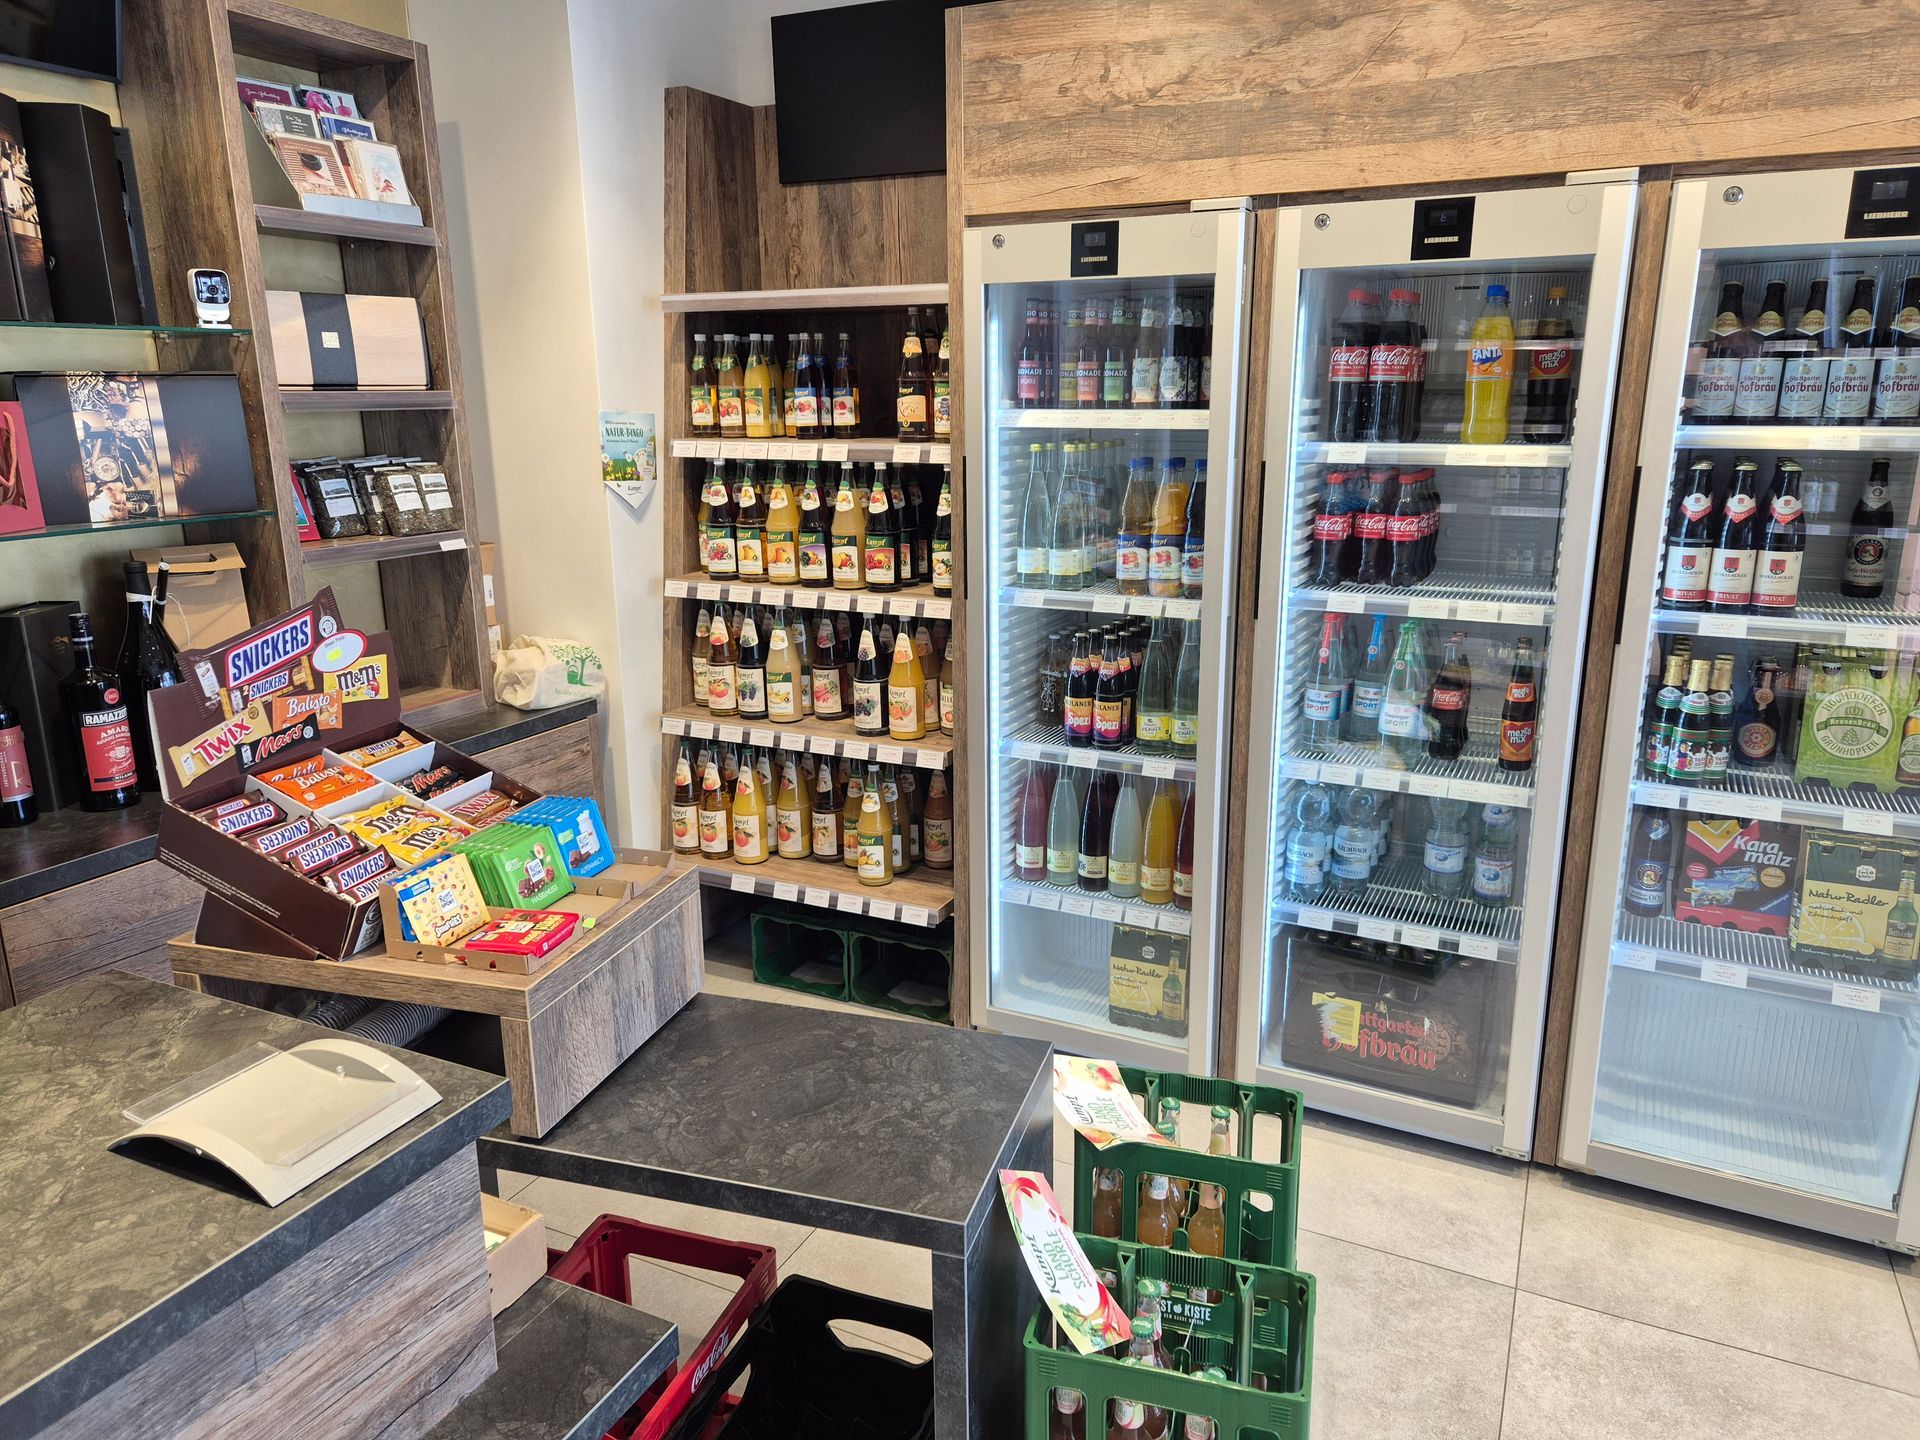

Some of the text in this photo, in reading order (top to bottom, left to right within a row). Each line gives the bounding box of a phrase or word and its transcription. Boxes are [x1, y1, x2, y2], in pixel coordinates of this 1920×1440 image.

[1472, 346, 1502, 360] FANTA
[231, 617, 309, 683] SNICKERS
[243, 685, 249, 696] 2
[251, 672, 287, 698] SNICKERS
[287, 696, 329, 717] Balisto
[1822, 691, 1887, 716] HOCHDORFER
[1067, 712, 1091, 726] Spezi
[1095, 716, 1119, 732] Spezi
[255, 724, 303, 762] Mars
[1510, 735, 1527, 744] mix
[295, 766, 341, 789] Balisto
[412, 765, 452, 793] Mars
[220, 804, 274, 833] SNICKERS
[259, 820, 309, 851] SNICKERS
[1734, 835, 1780, 854] Kara
[301, 837, 351, 868] SNICKERS
[1744, 850, 1793, 868] malz
[341, 852, 386, 888] SNICKERS
[1043, 1242, 1070, 1280] LAND
[1045, 1229, 1087, 1290] SCHORLE
[1184, 1303, 1212, 1321] KISTE
